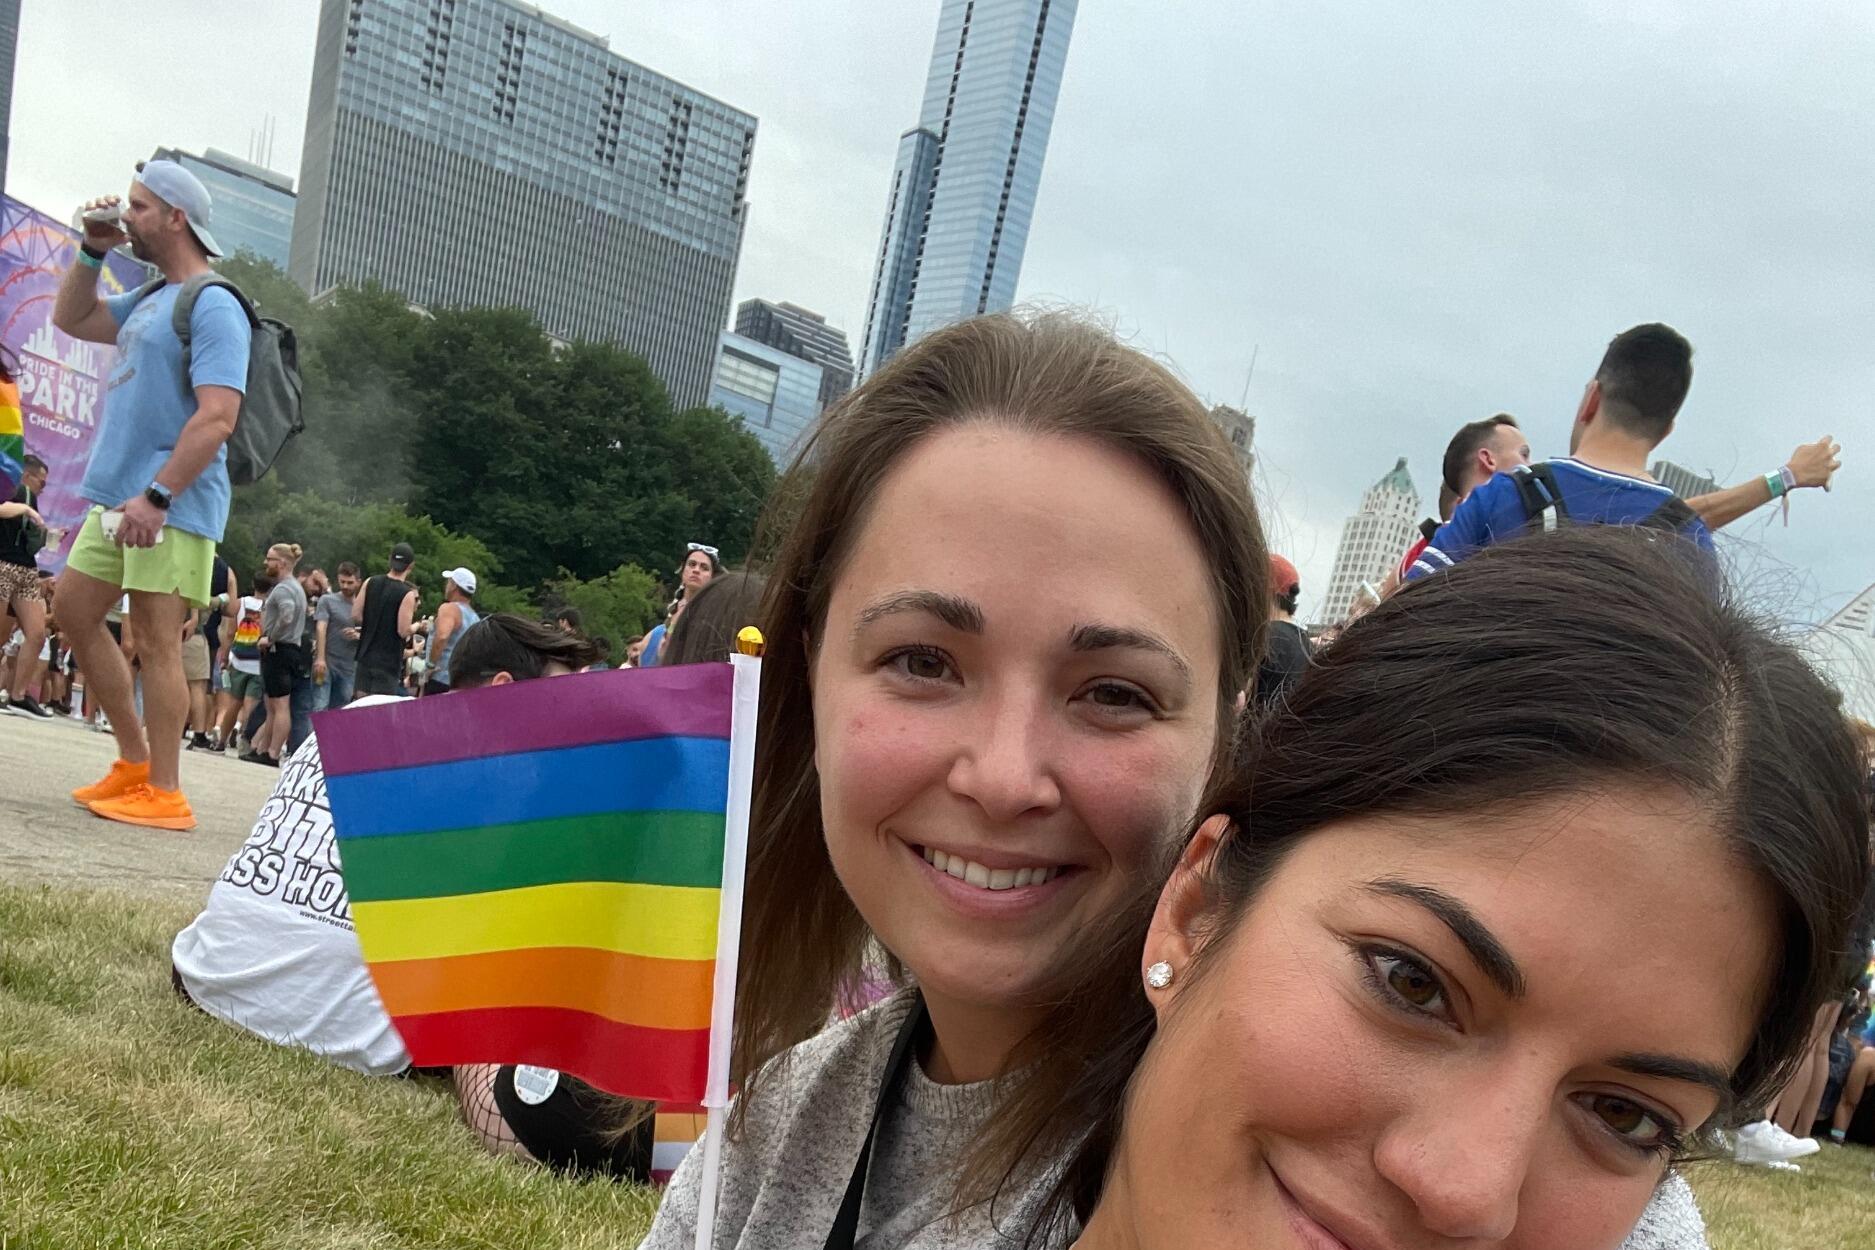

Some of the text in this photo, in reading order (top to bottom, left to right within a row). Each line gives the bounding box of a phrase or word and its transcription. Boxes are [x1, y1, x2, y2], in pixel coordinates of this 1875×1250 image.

[19, 354, 56, 379] PRIDE
[59, 369, 74, 386] IN
[75, 375, 98, 397] THE
[17, 369, 98, 427] PARK
[28, 412, 81, 439] CHICAGO
